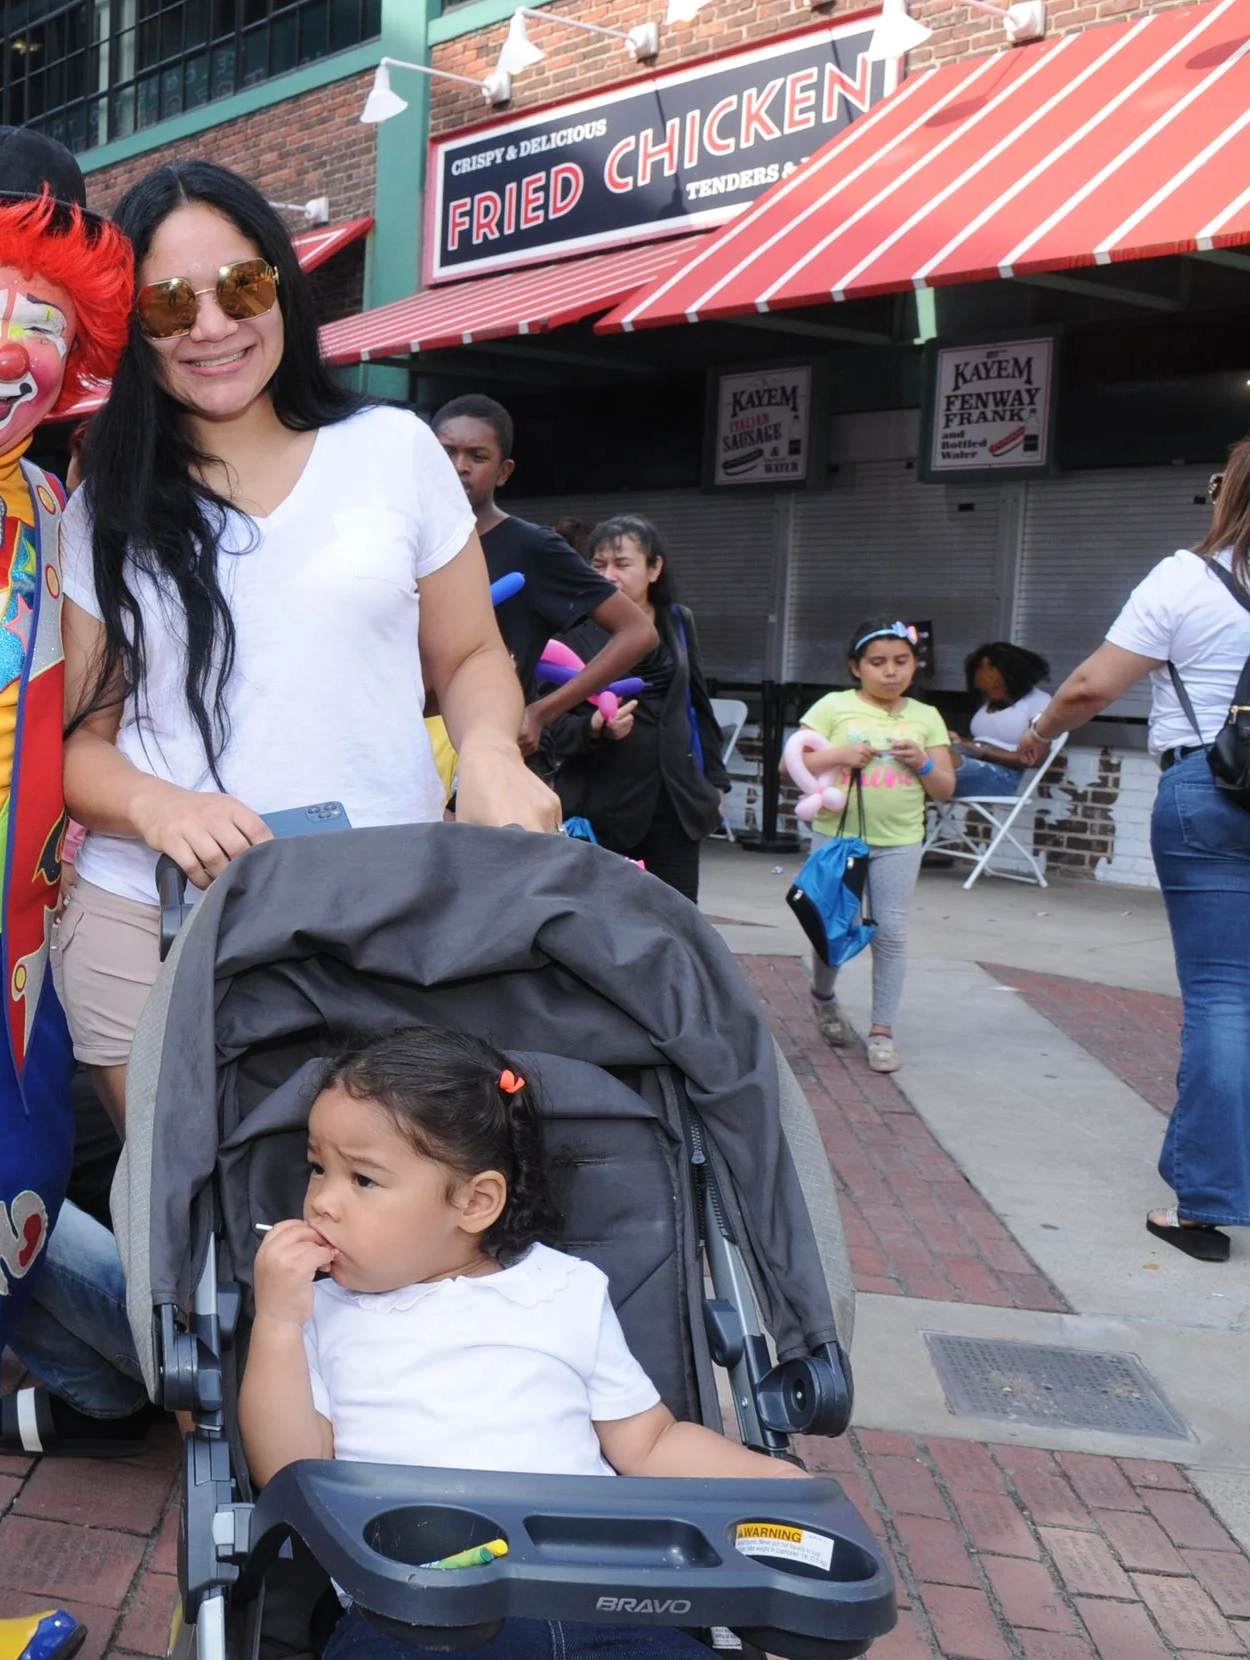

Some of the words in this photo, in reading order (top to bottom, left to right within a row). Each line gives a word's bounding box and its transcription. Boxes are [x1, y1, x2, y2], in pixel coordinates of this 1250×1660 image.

[447, 162, 584, 251] FRIED
[603, 51, 872, 194] CHICKEN
[451, 146, 503, 175] CRISPY
[505, 146, 518, 162] &
[519, 118, 608, 158] DELICIOUS
[685, 163, 779, 201] TENDERS
[951, 357, 1034, 392] KAYEM
[730, 385, 799, 418] KAYEM
[944, 387, 1041, 412] FENWAY
[729, 412, 770, 433] ITALIAN
[943, 408, 1025, 429] FRANK
[722, 422, 783, 453] SAUSAGE
[941, 430, 966, 440] and
[941, 438, 988, 450] Bottled
[941, 450, 979, 460] Water
[744, 1527, 802, 1544] WARNING
[596, 1596, 692, 1614] BRAVO
